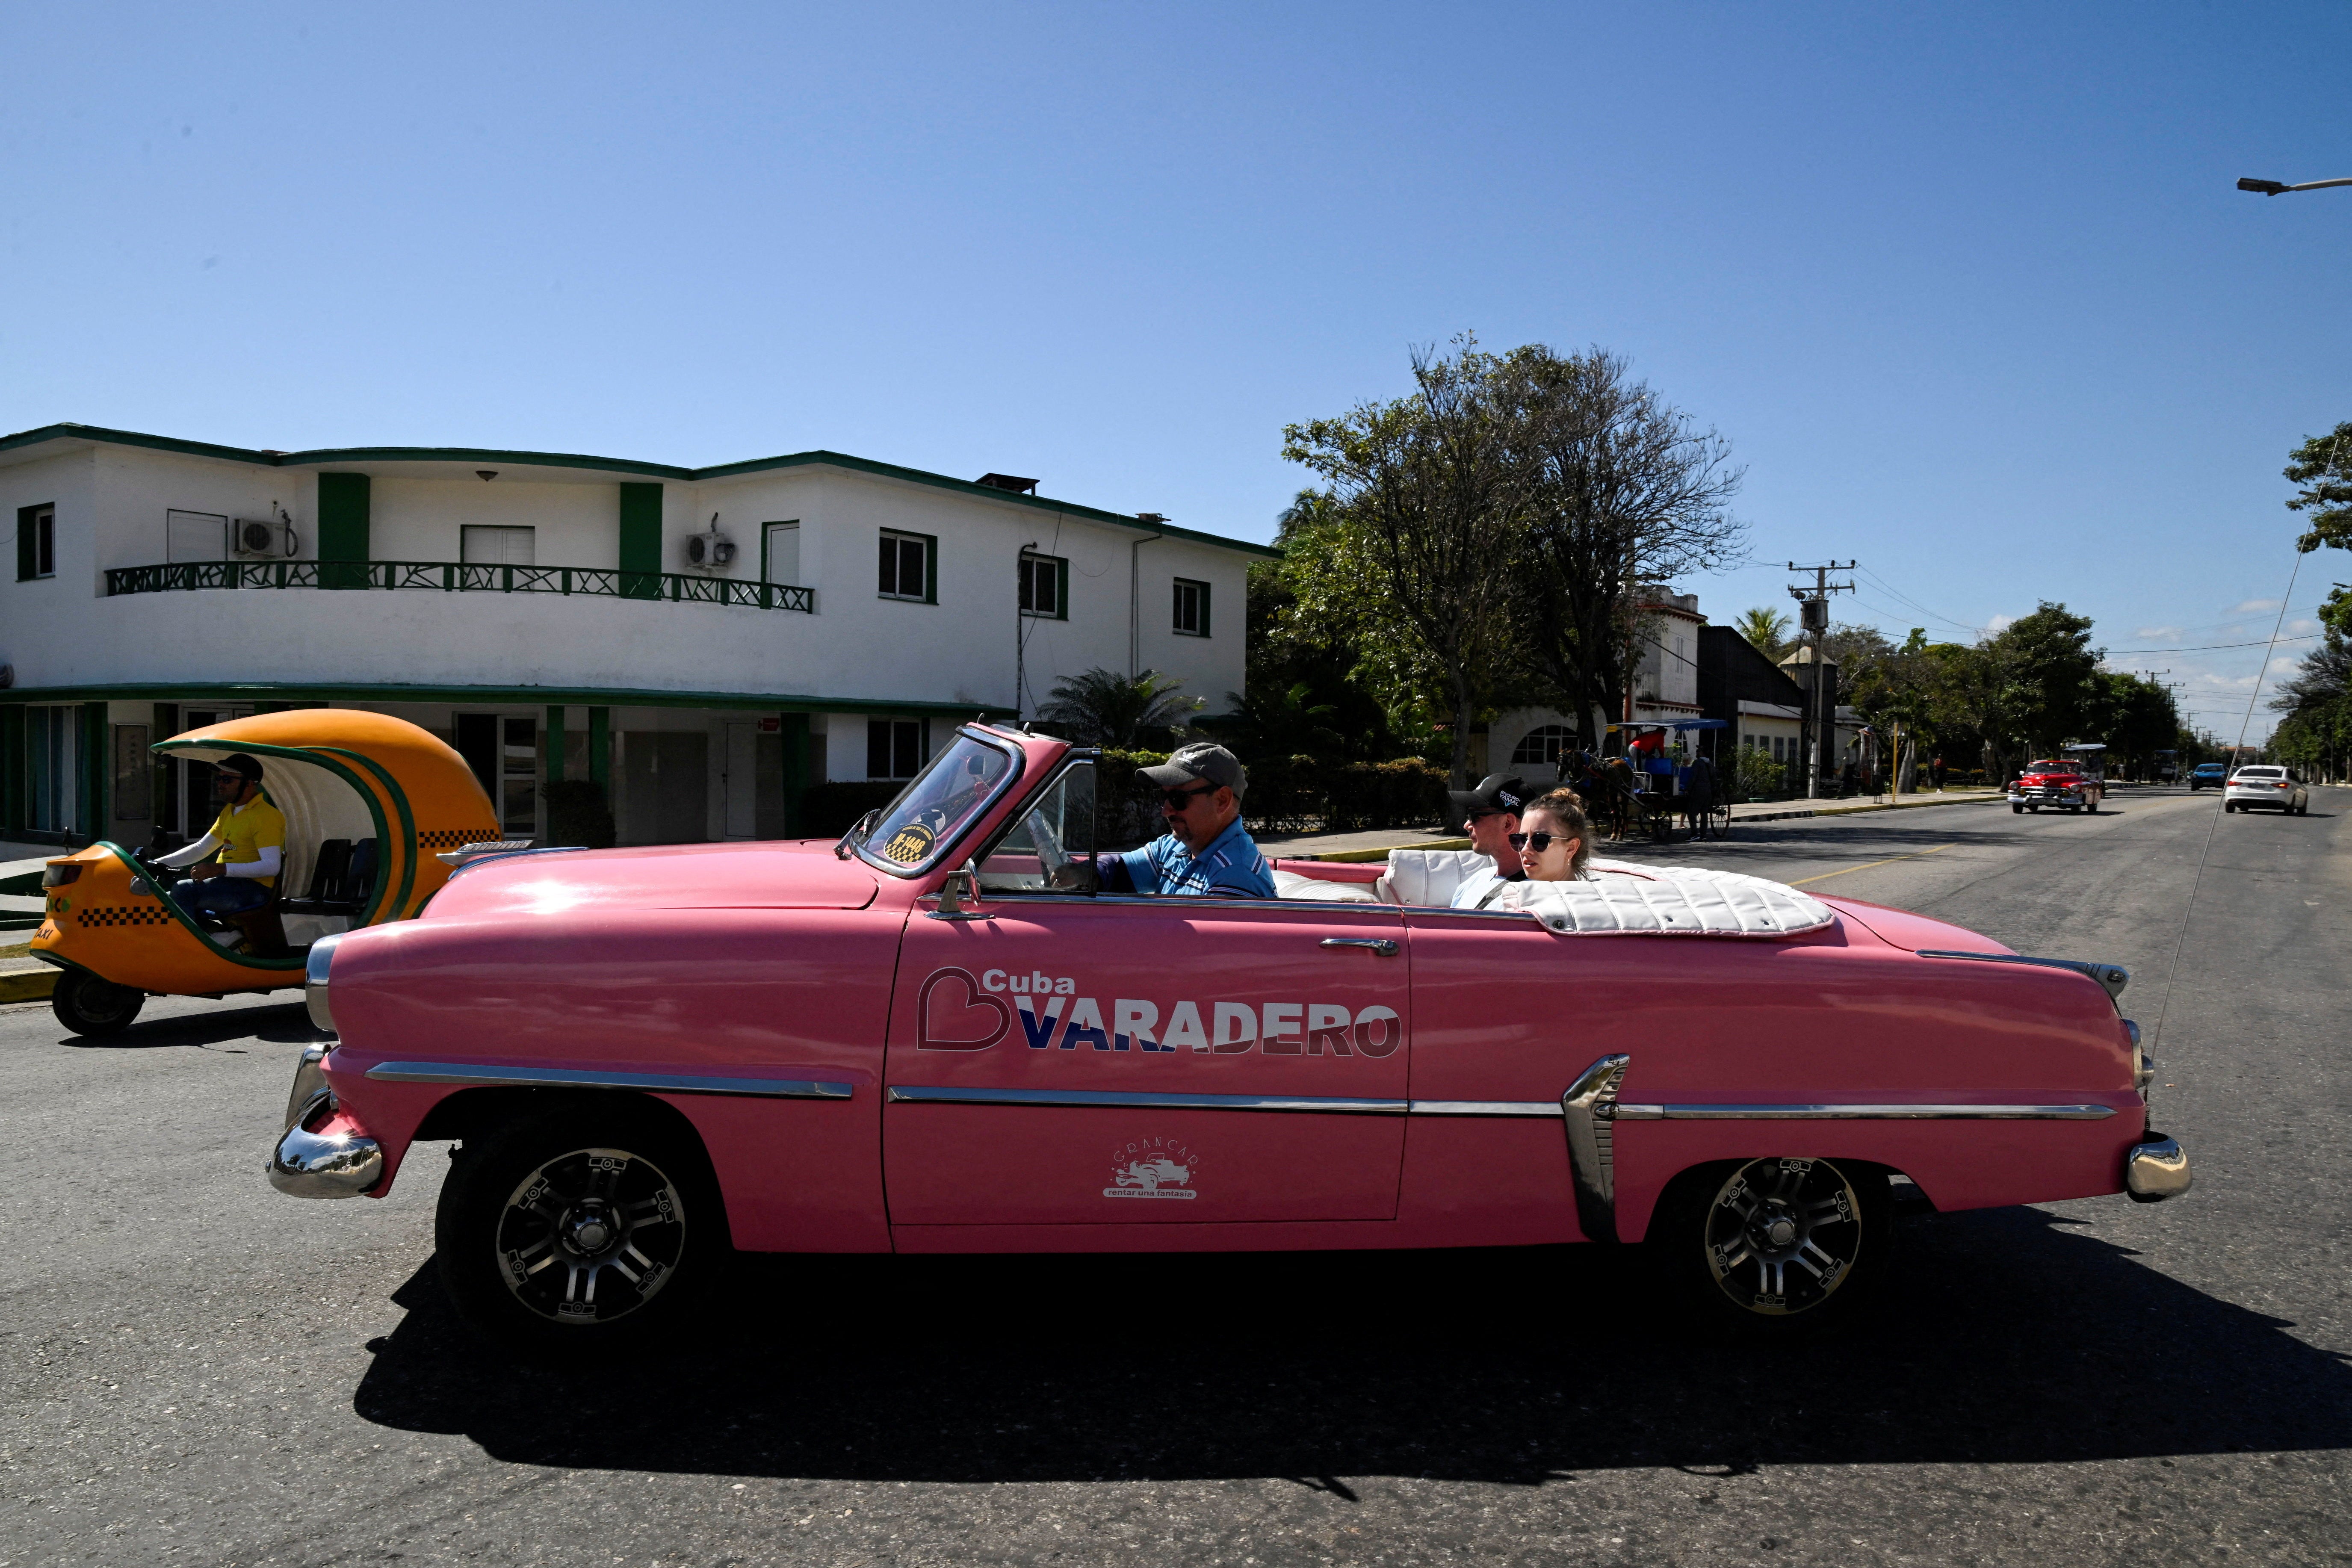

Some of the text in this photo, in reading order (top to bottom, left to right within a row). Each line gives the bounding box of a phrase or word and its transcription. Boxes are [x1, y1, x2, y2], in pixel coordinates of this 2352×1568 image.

[1499, 793, 1519, 806] YAMAL
[1501, 791, 1519, 802] ENDURO
[892, 833, 926, 853] M-1448
[982, 969, 1075, 994] Cuba
[1014, 995, 1402, 1058] VARADERO
[1114, 1137, 1198, 1166] GRANCAR
